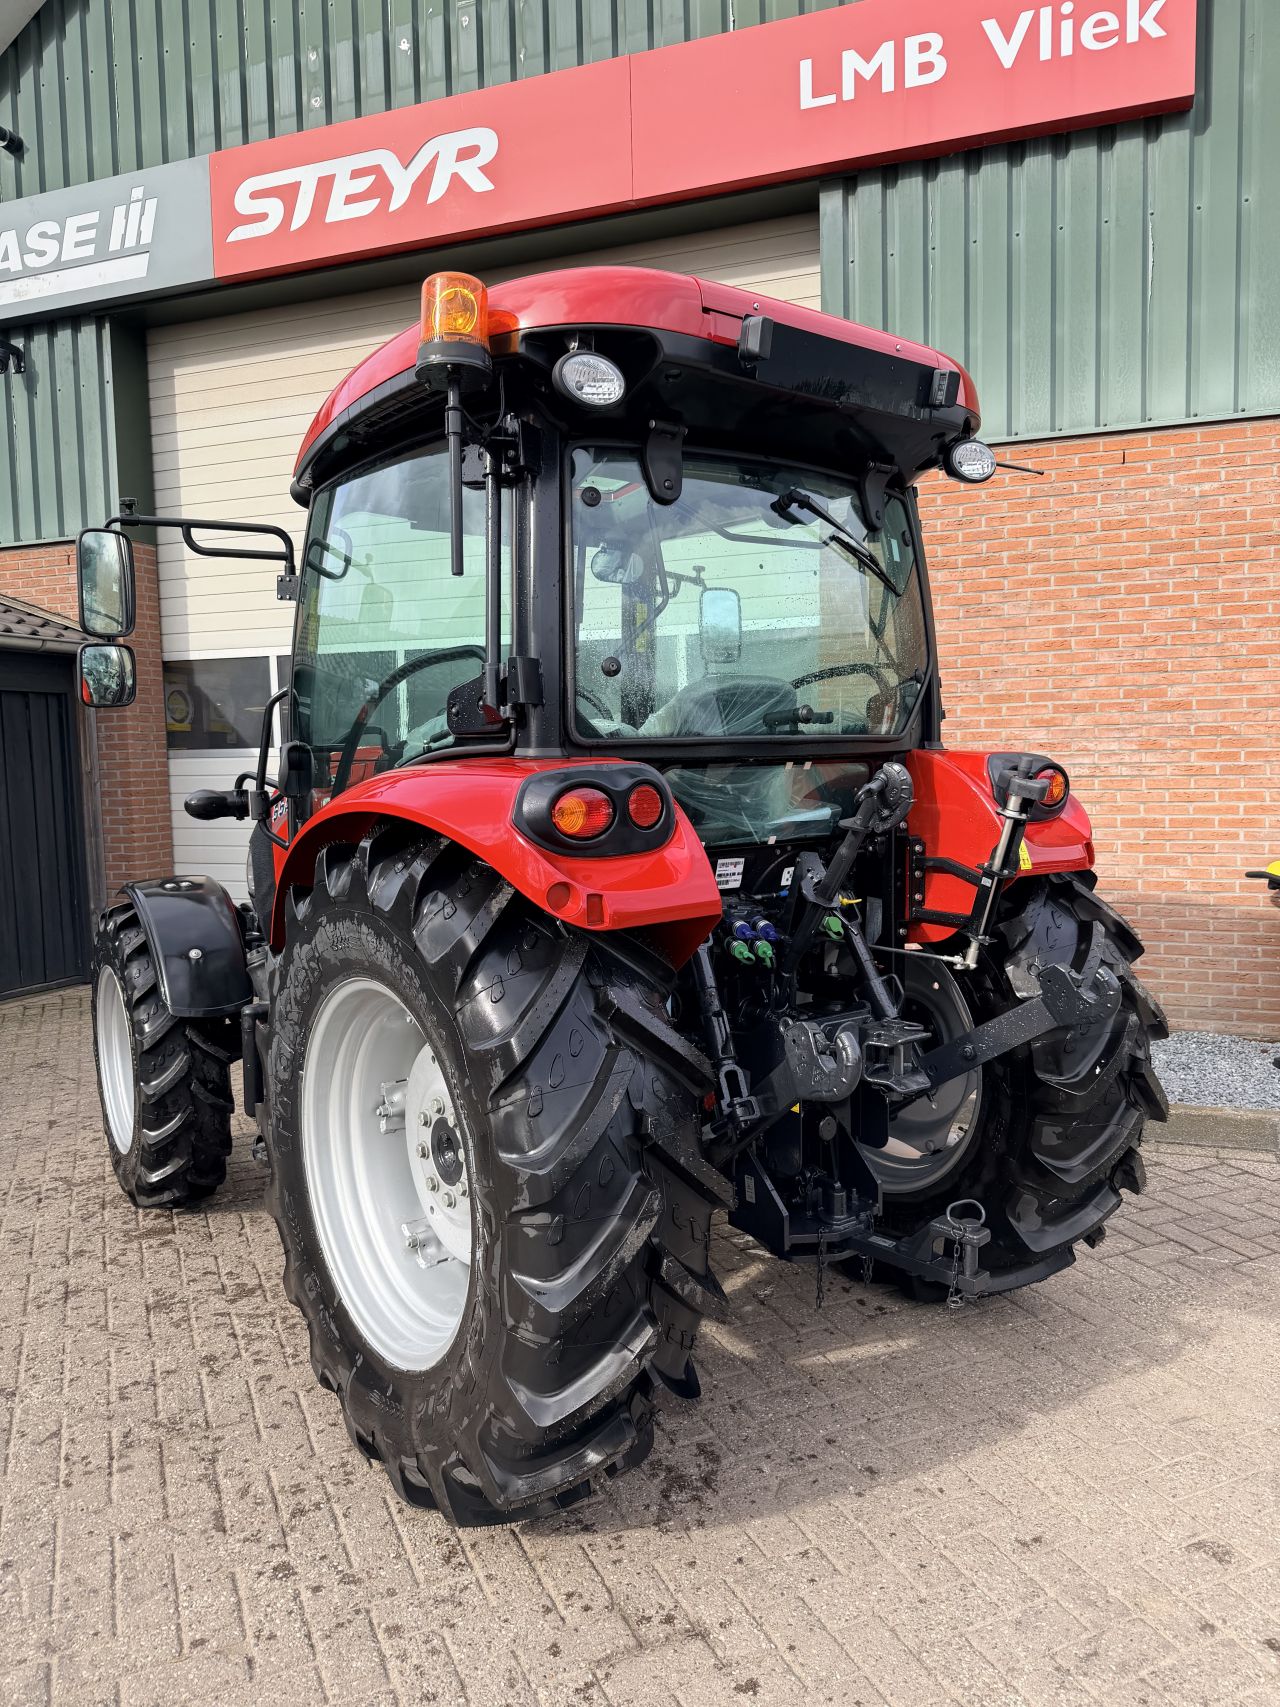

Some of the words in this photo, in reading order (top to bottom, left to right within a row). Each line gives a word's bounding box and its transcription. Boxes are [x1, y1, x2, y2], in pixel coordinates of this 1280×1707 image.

[800, 32, 947, 110] LMB
[981, 0, 1167, 69] Vliek
[226, 126, 499, 243] STEYR
